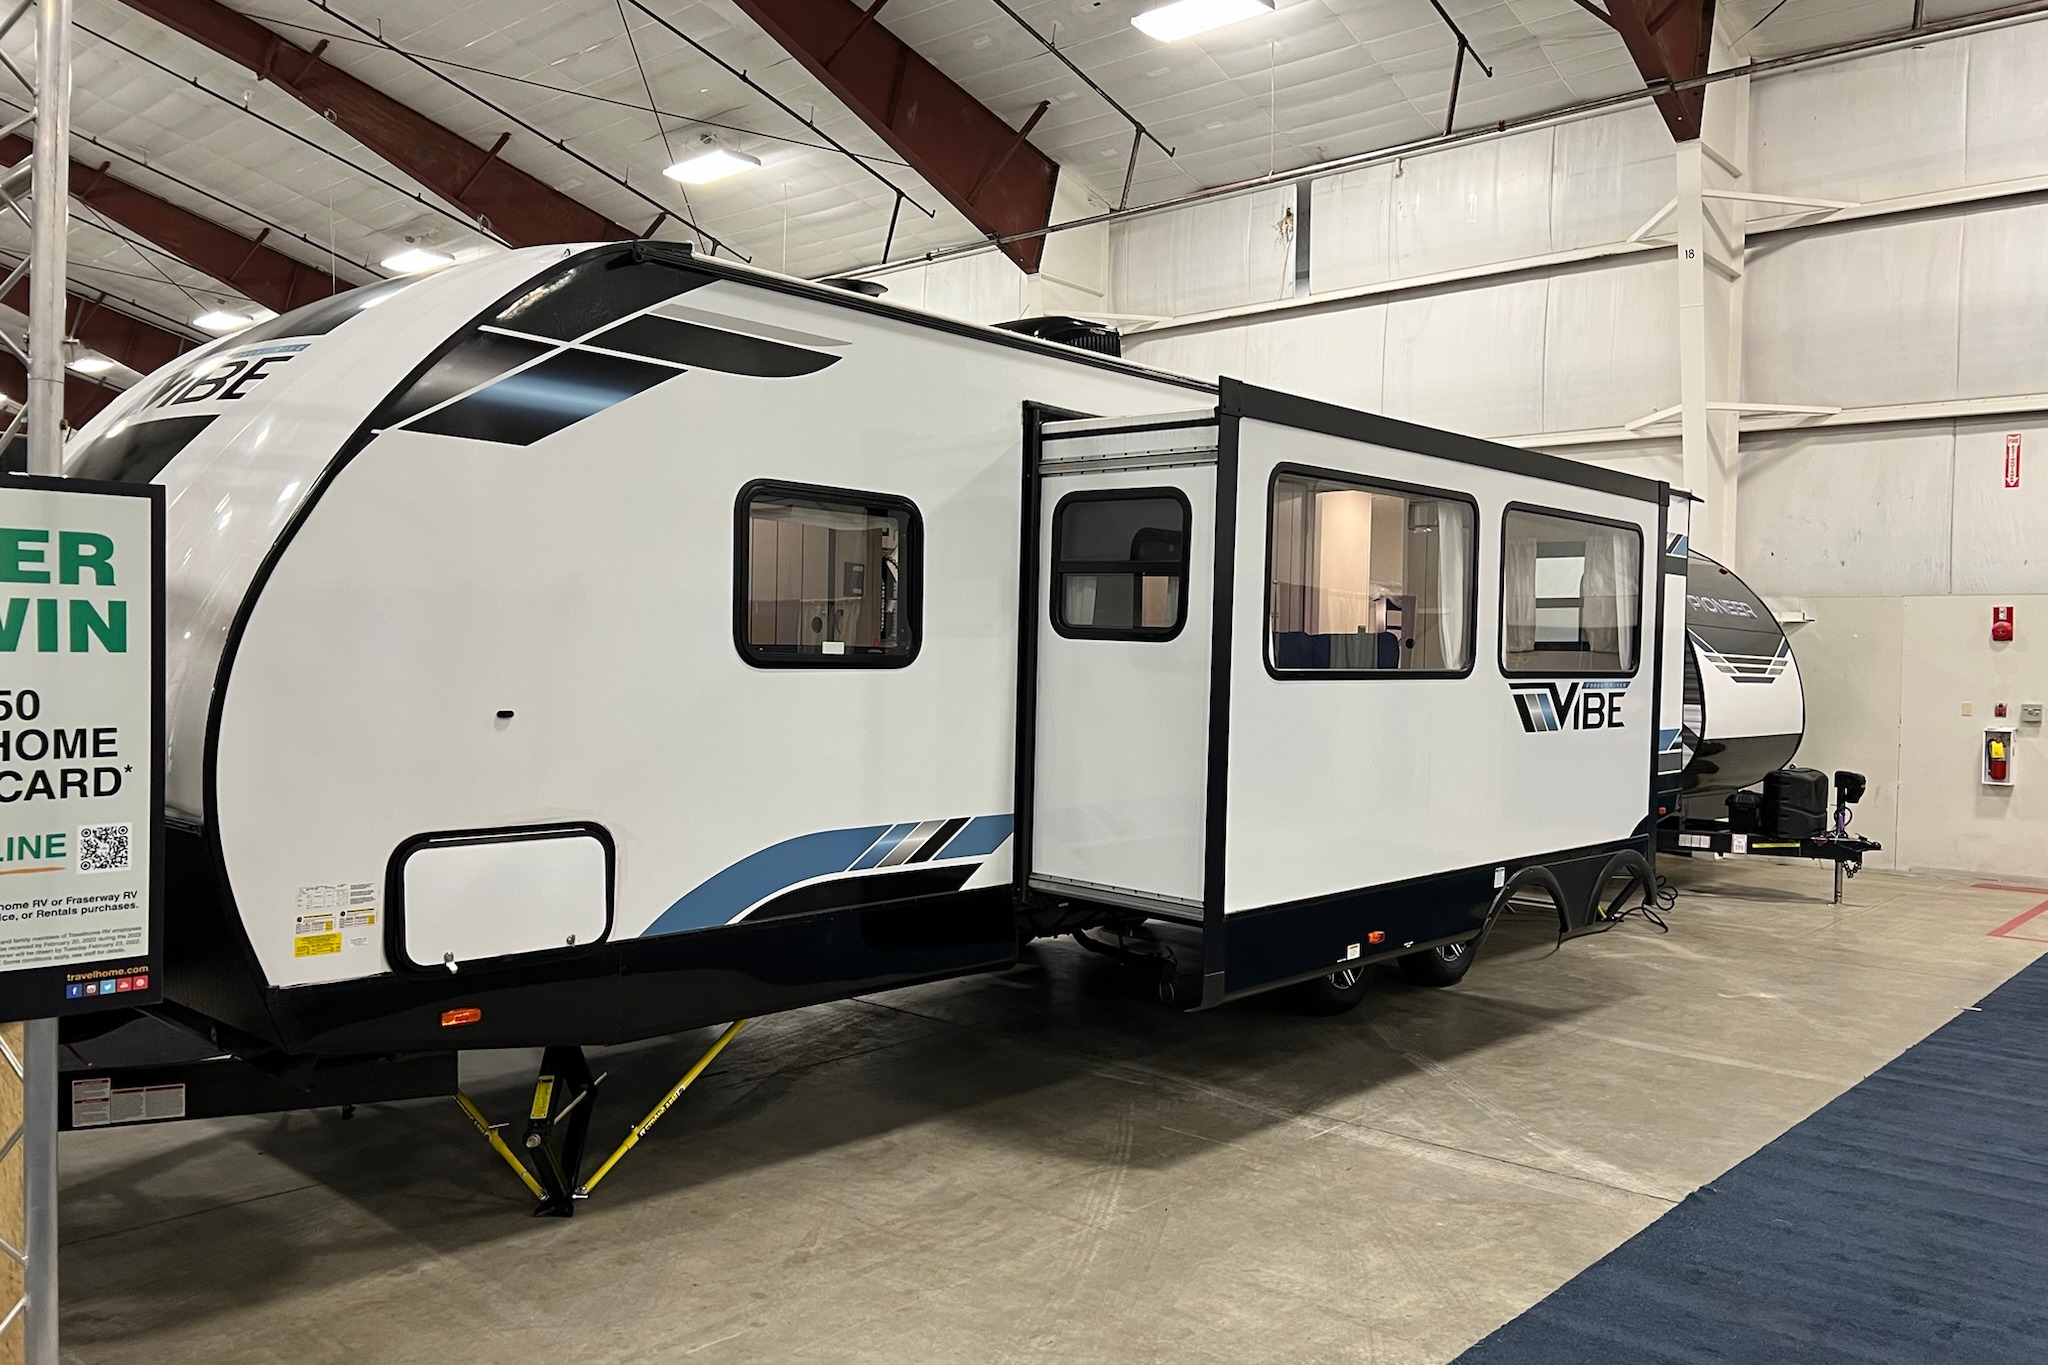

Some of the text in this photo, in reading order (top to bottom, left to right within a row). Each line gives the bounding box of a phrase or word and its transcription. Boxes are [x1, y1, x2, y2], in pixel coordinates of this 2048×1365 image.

[1685, 248, 1695, 259] 18
[0, 527, 116, 586] ER
[1686, 594, 1758, 619] PIONEER
[1508, 682, 1626, 732] VIBE
[0, 833, 67, 862] INE
[32, 898, 48, 908] RV
[66, 893, 120, 905] Fraserway
[123, 890, 138, 899] RV
[21, 911, 33, 919] or
[36, 907, 78, 918] Rentals
[81, 902, 139, 916] purchases.
[67, 965, 149, 982] travelhome.com
